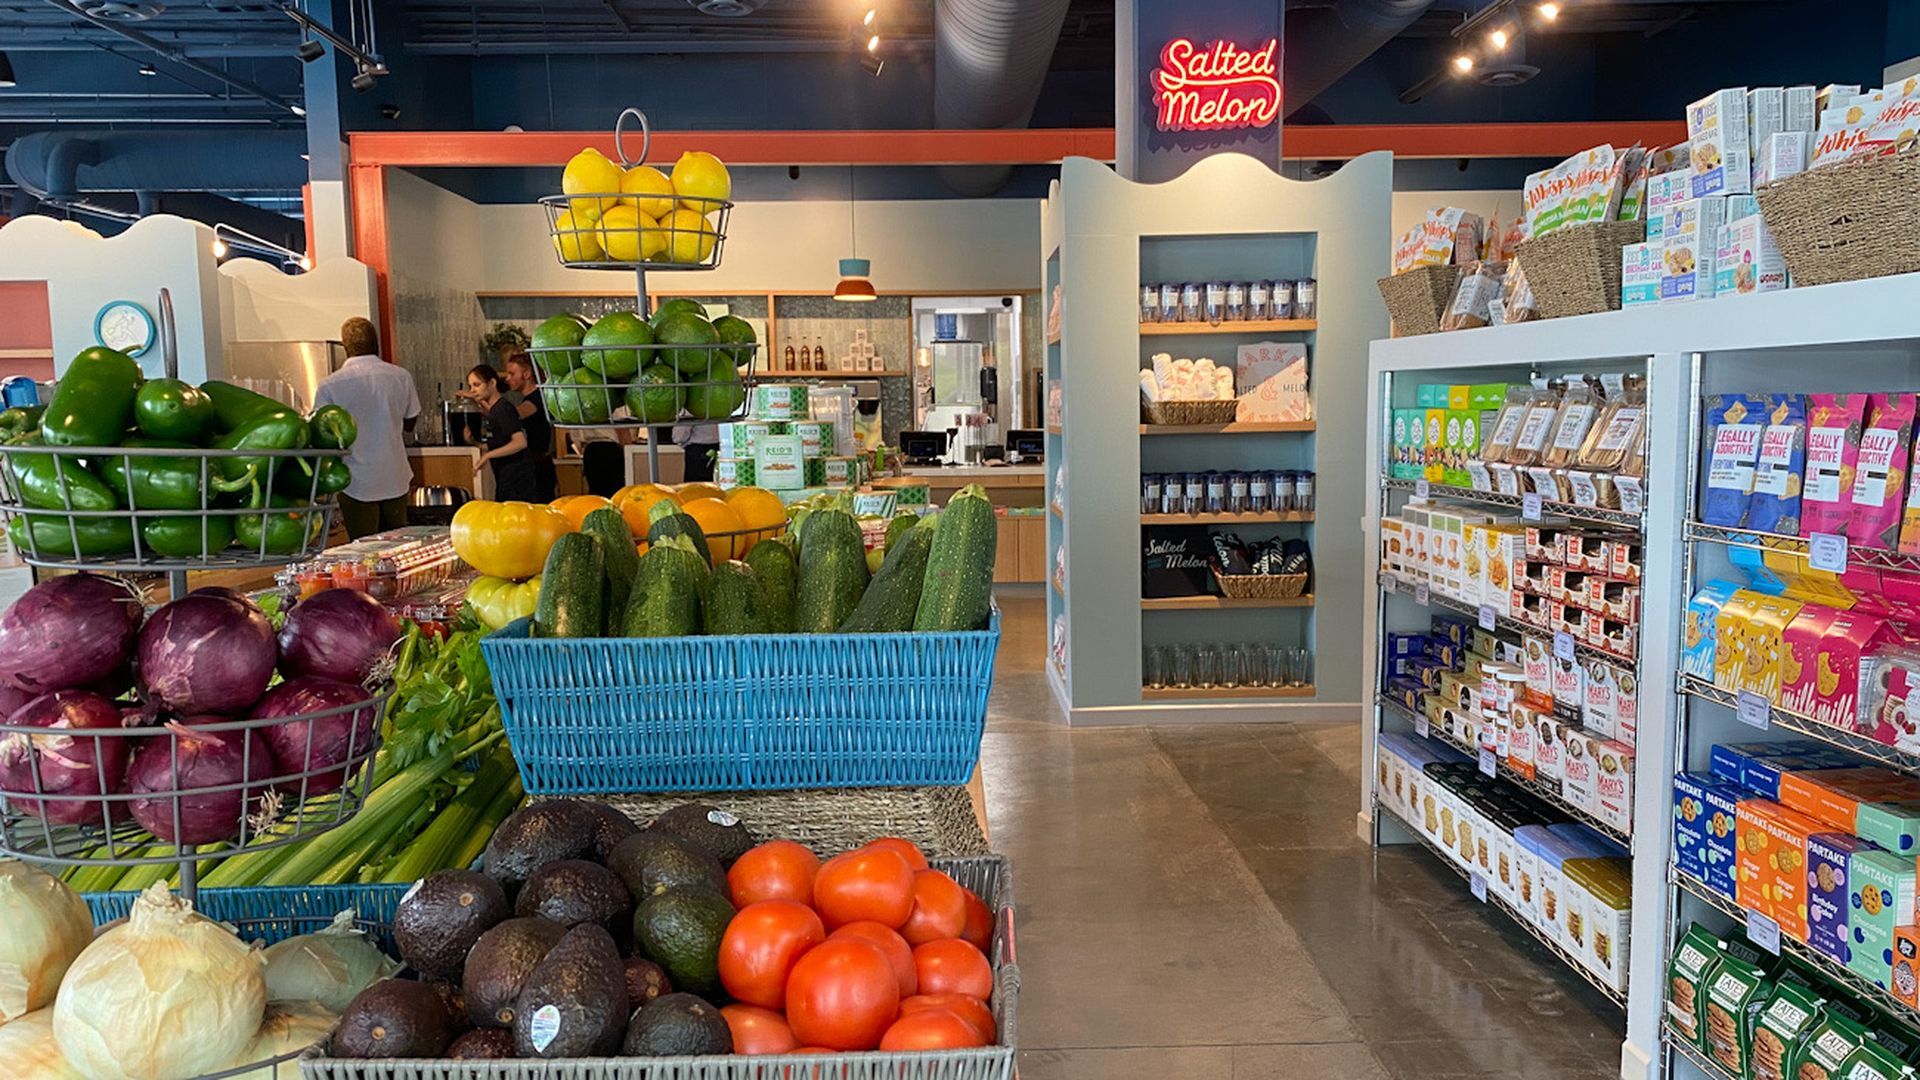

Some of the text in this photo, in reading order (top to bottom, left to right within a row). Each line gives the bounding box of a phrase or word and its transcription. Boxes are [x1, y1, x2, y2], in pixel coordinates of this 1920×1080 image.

[1160, 38, 1276, 82] Salted
[1161, 87, 1276, 124] Melon
[1528, 171, 1576, 208] Whisps
[1283, 383, 1305, 392] MELO
[1718, 430, 1757, 443] LEGALLY
[765, 446, 794, 456] REID'S
[1715, 444, 1754, 456] ADDICTIVE
[1145, 539, 1187, 556] Salted
[1165, 555, 1208, 569] Melon
[1554, 670, 1578, 687] MARY'S
[1587, 683, 1611, 700] MARY'S
[1617, 696, 1636, 714] MARY
[1817, 693, 1854, 730] milk
[1565, 757, 1590, 777] MARY'S
[1597, 773, 1625, 795] MARY'S
[1674, 778, 1703, 799] PARTAKE
[1706, 792, 1736, 814] PARTAKE
[1736, 807, 1768, 831] PARTAKE
[1676, 822, 1702, 840] Chocolate
[1768, 825, 1802, 849] PARTAKE
[1707, 838, 1733, 857] Chocolate
[1808, 840, 1846, 867] PARTAKE
[1853, 860, 1894, 888] PARTAKE
[1853, 913, 1888, 938] Chocolate
